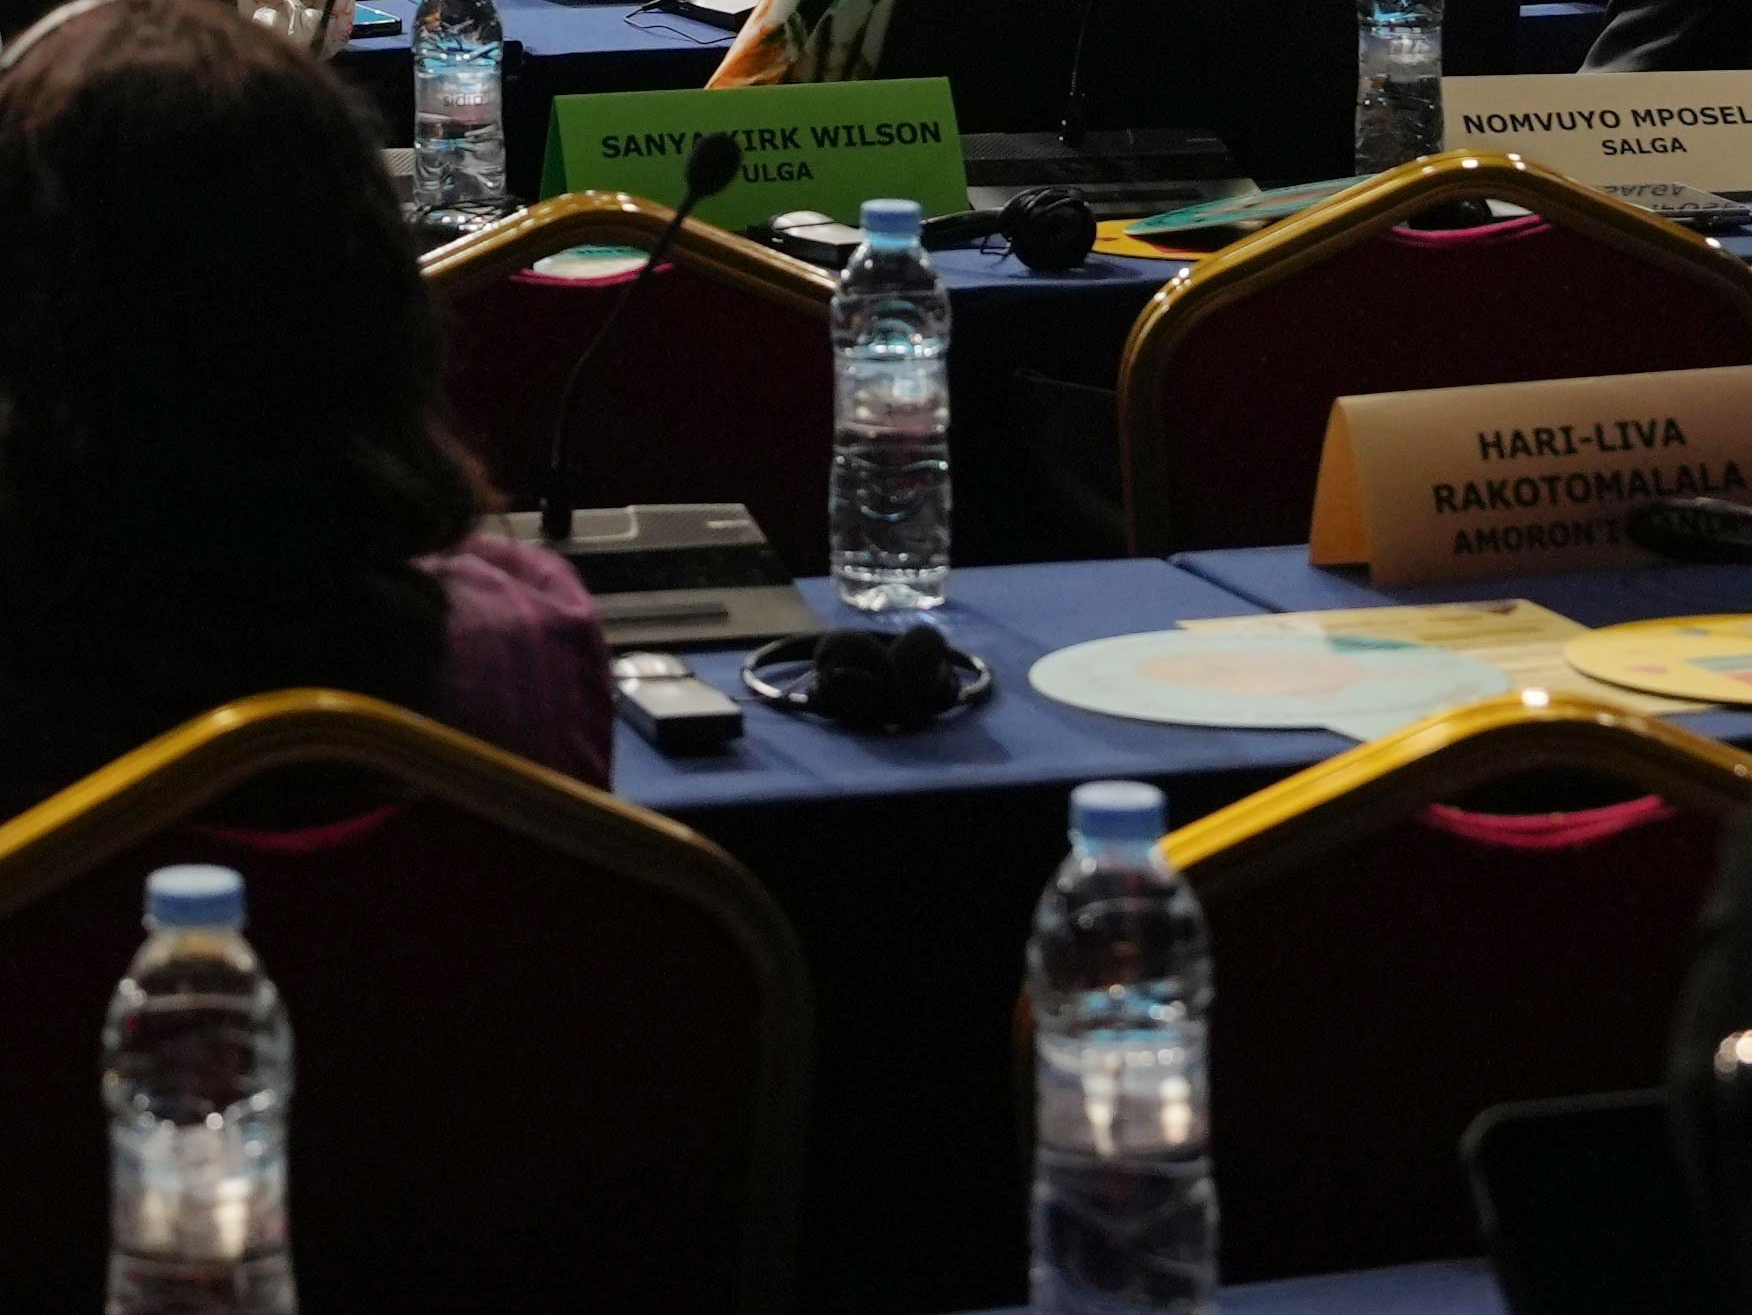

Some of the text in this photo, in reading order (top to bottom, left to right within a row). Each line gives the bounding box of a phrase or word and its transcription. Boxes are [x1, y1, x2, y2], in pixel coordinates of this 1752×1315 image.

[732, 127, 801, 152] IRK
[811, 121, 941, 148] WILSON
[1463, 108, 1621, 135] NOMVUYO
[1602, 137, 1688, 156] SALGA
[1479, 417, 1686, 461] HARI-LIVA
[1433, 461, 1748, 514] RAKOTOMALALA
